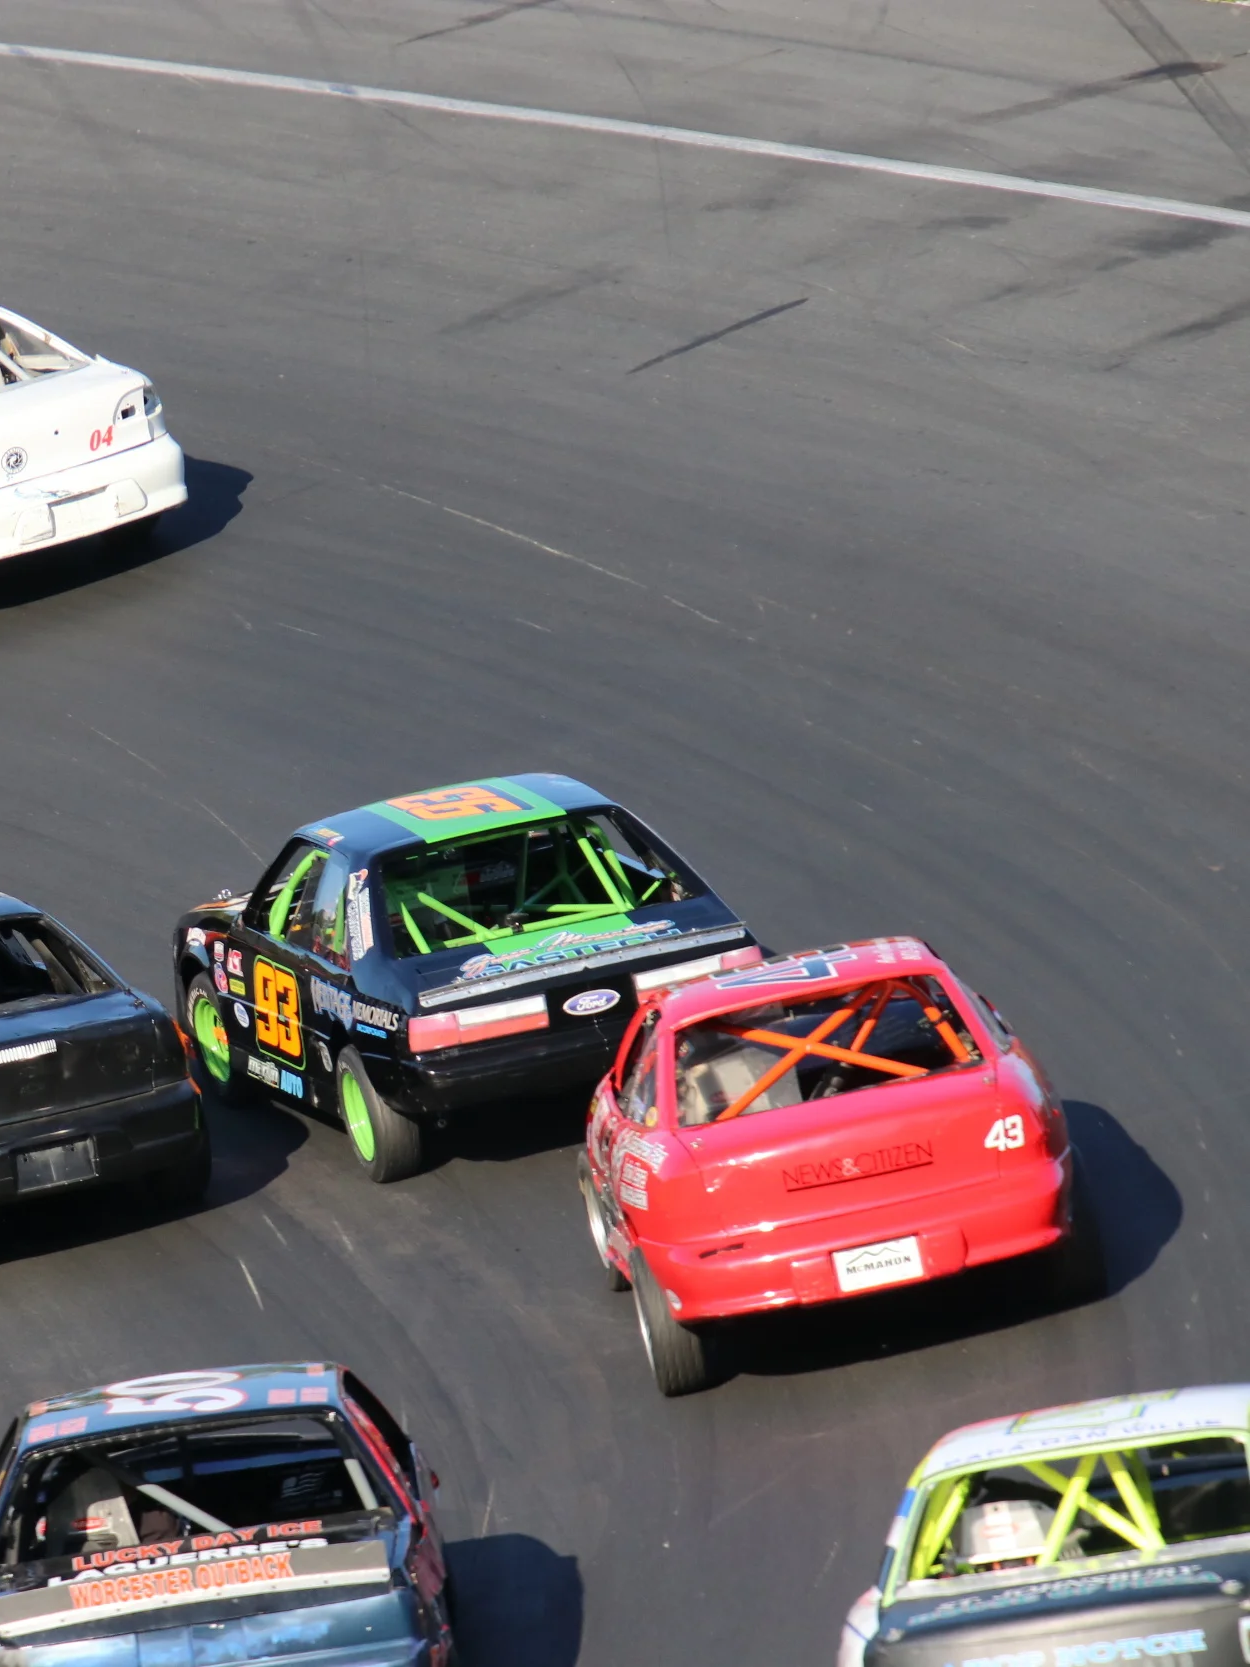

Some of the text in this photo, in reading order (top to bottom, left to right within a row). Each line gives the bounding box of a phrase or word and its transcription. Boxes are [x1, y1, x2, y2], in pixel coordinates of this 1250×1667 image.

[90, 425, 113, 451] 04
[254, 961, 301, 1057] 93
[352, 1000, 400, 1032] MEMORIALS
[576, 995, 608, 1011] Ford
[280, 1069, 304, 1099] AUTO
[984, 1114, 1025, 1151] 43
[72, 1519, 323, 1571] LUCKY DAY ICE
[69, 1551, 296, 1610] WORCESTER OUTBACK
[1053, 1628, 1208, 1666] NOTCH
